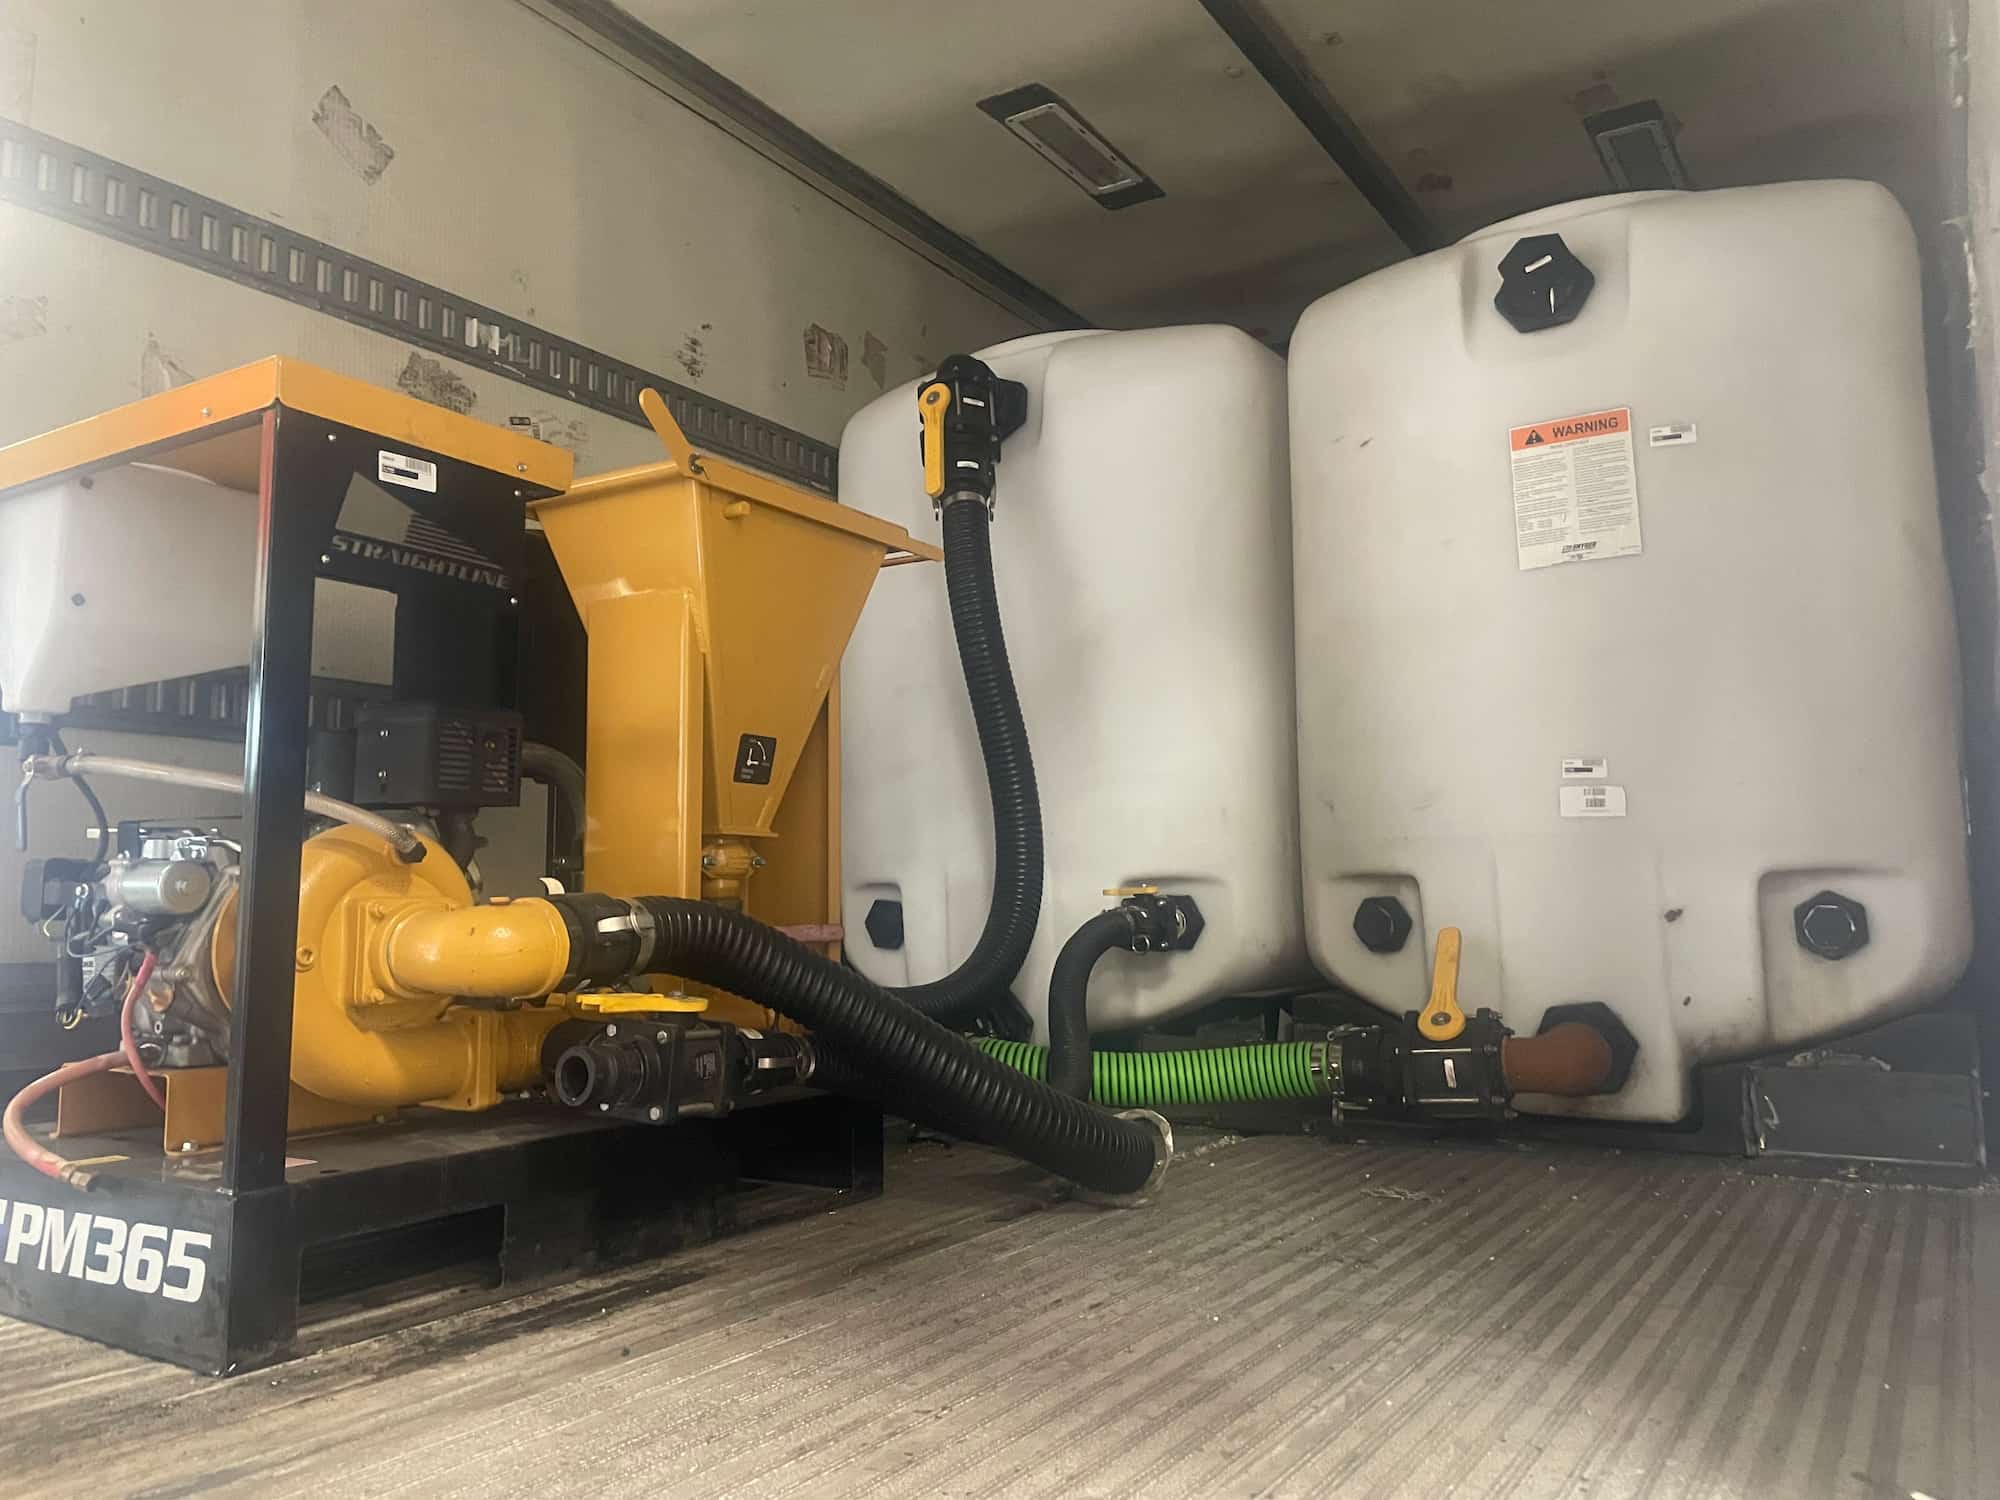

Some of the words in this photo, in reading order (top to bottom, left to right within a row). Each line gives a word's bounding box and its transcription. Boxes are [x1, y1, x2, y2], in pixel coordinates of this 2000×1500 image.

[1552, 417, 1618, 438] WARNING
[332, 535, 512, 590] STRAIGHTLINE
[0, 1199, 212, 1303] PM365
